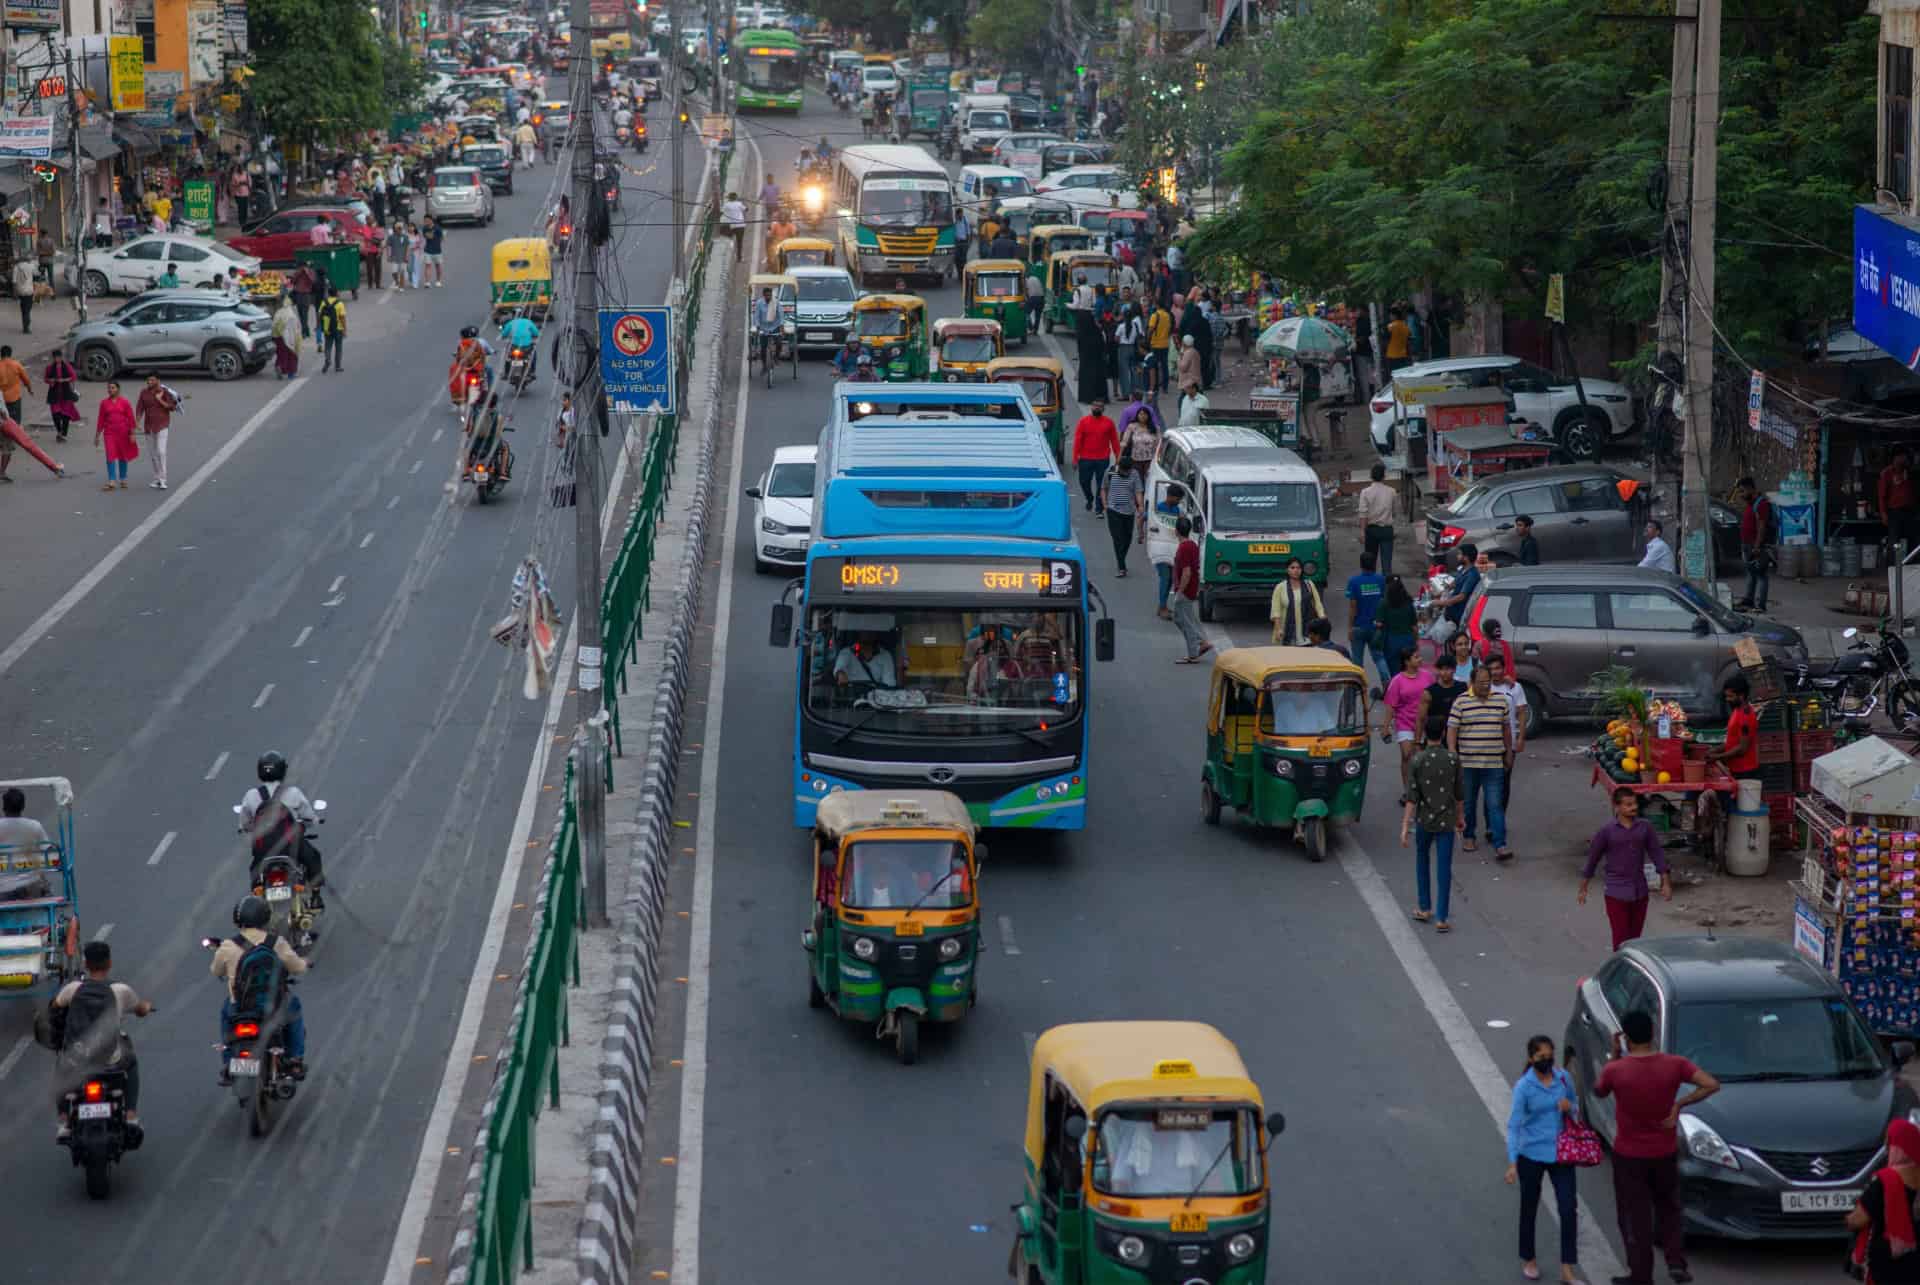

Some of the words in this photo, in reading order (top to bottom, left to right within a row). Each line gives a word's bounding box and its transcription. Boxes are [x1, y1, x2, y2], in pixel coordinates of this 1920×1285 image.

[1890, 272, 1903, 309] YES
[1903, 280, 1920, 319] BAN
[627, 359, 656, 368] ENTRY
[624, 371, 643, 381] FOR
[605, 384, 628, 393] EAVY
[630, 384, 667, 393] VEHICLES
